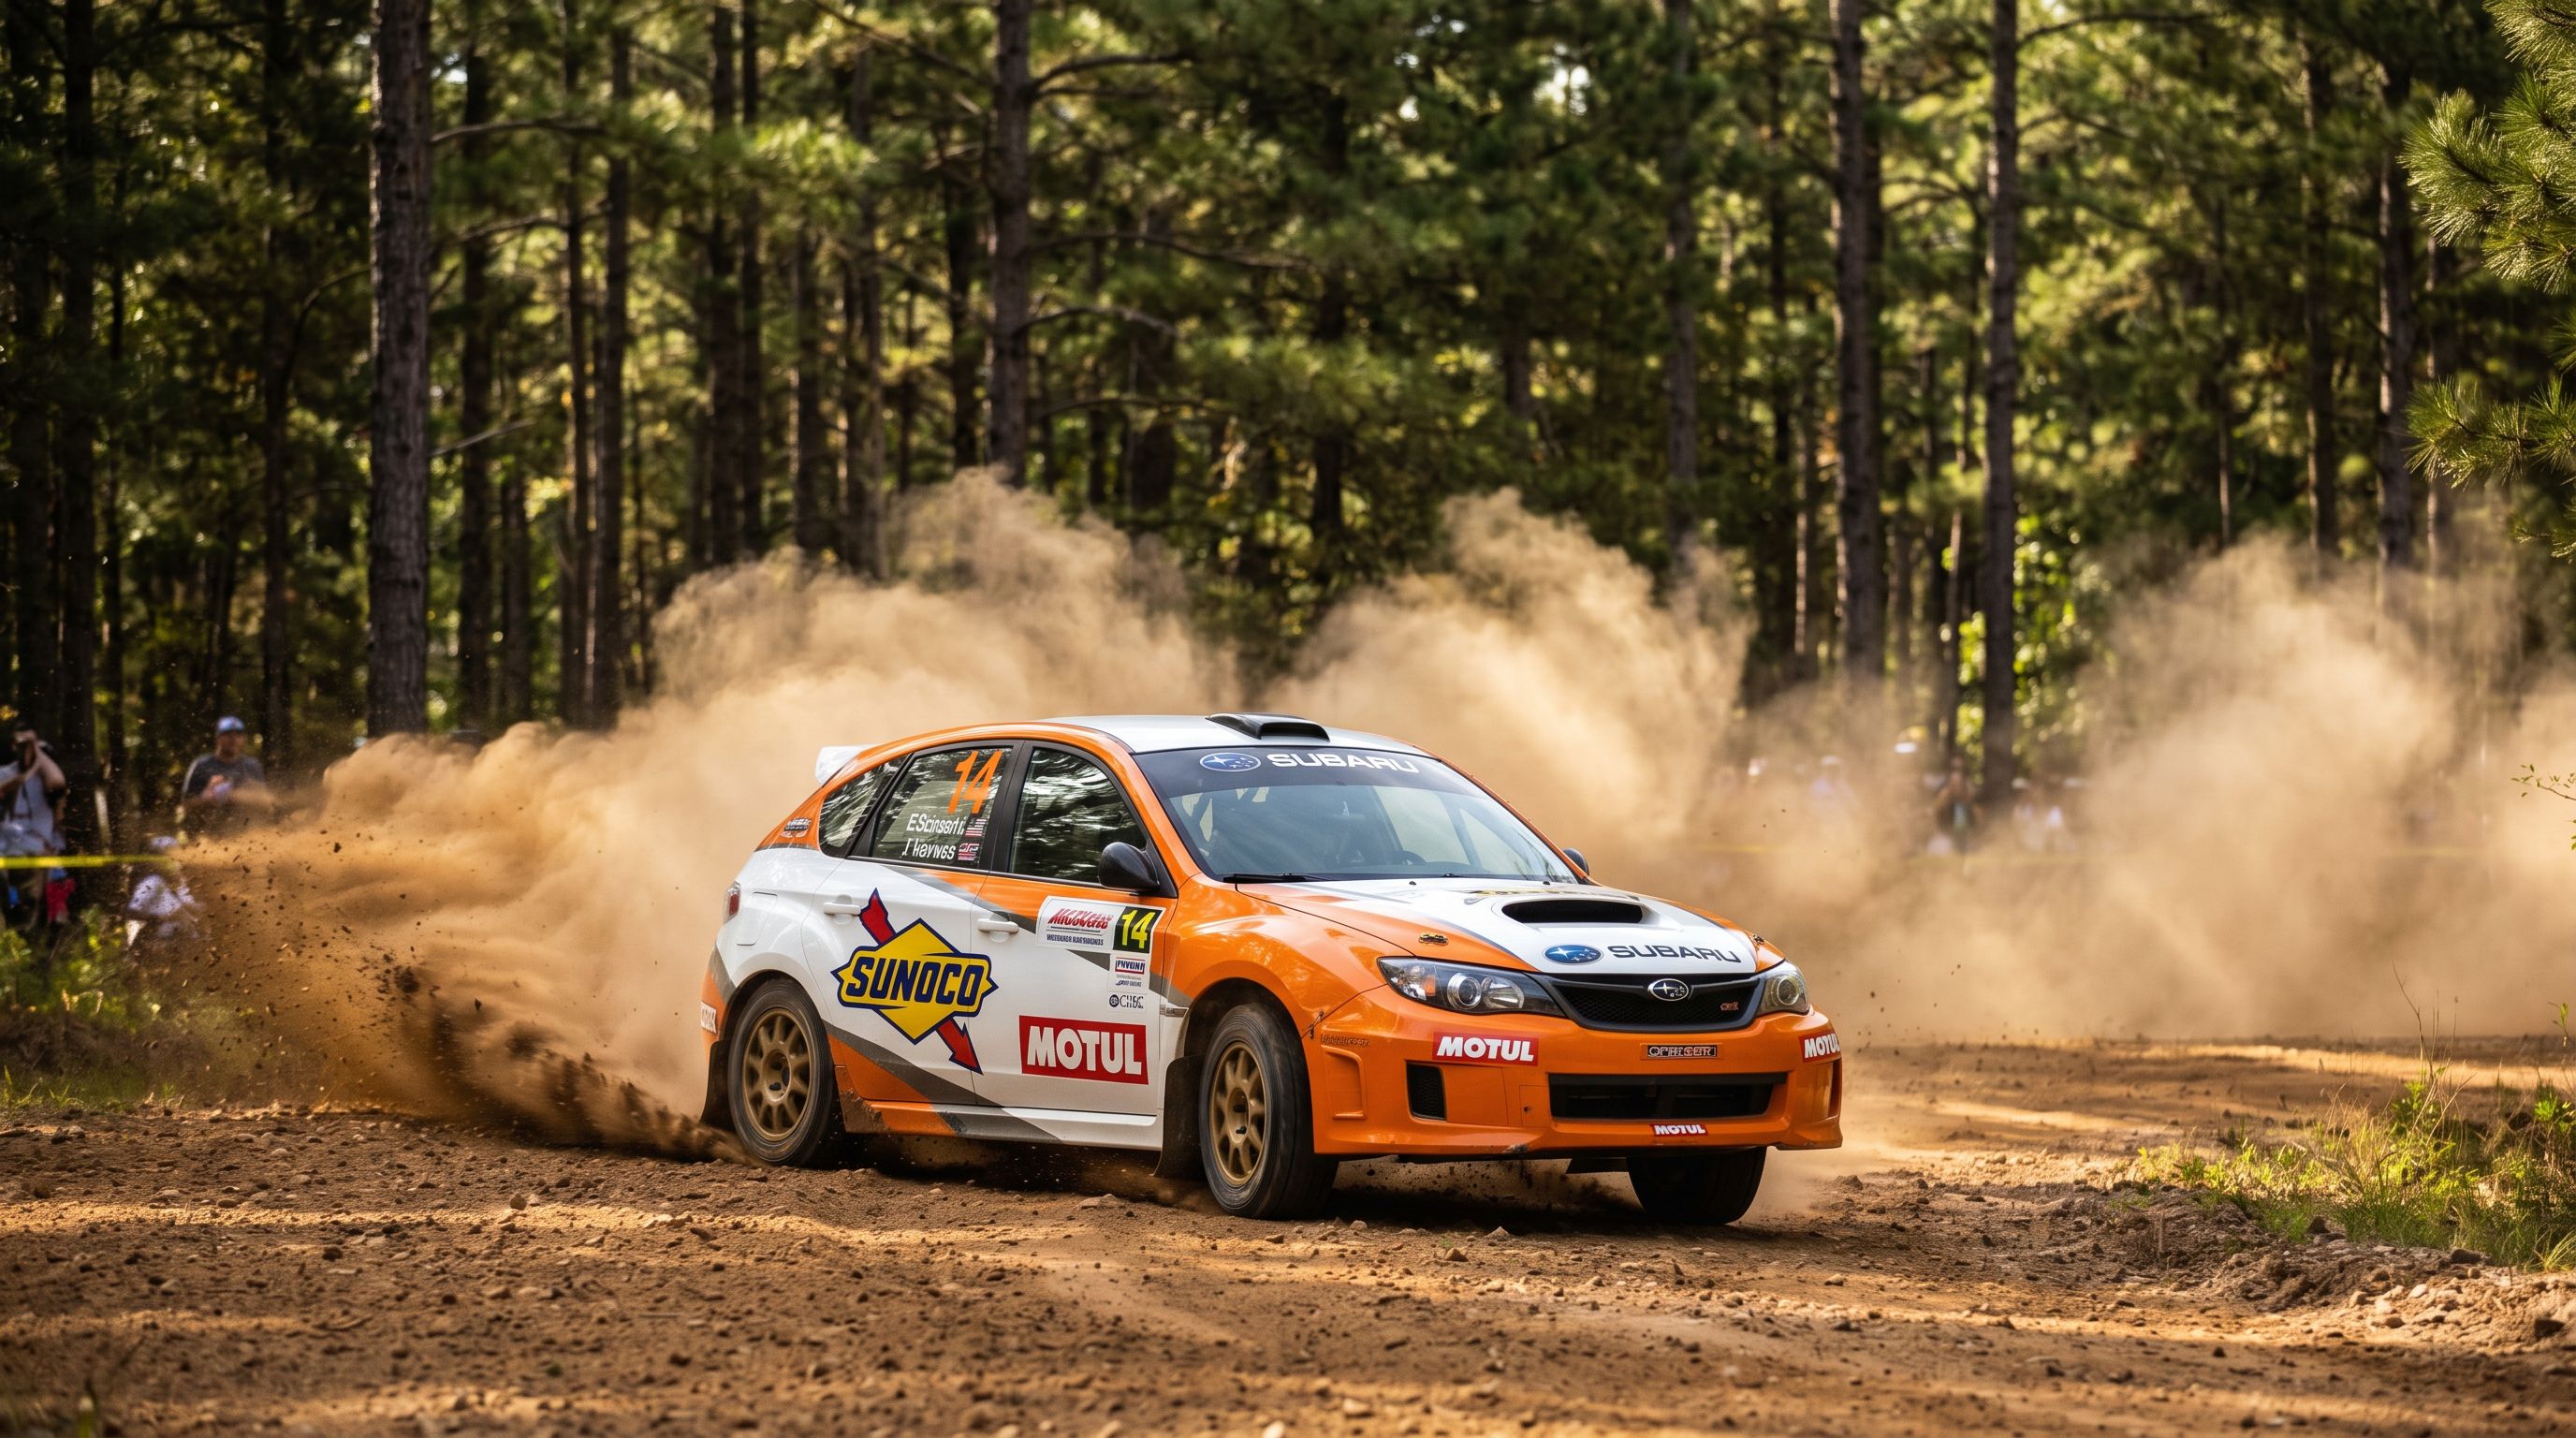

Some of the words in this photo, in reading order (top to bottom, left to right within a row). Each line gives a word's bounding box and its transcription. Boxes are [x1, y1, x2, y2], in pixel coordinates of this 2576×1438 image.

[1266, 754, 1420, 773] SUBARU
[947, 750, 1003, 814] 14
[1121, 909, 1156, 949] 14
[1607, 945, 1741, 963] SUBARU
[845, 956, 985, 1006] SUNOCO
[1027, 1025, 1142, 1076] MOTUL
[1436, 1035, 1534, 1062] MOTUL
[1654, 1124, 1706, 1135] MOTUL
